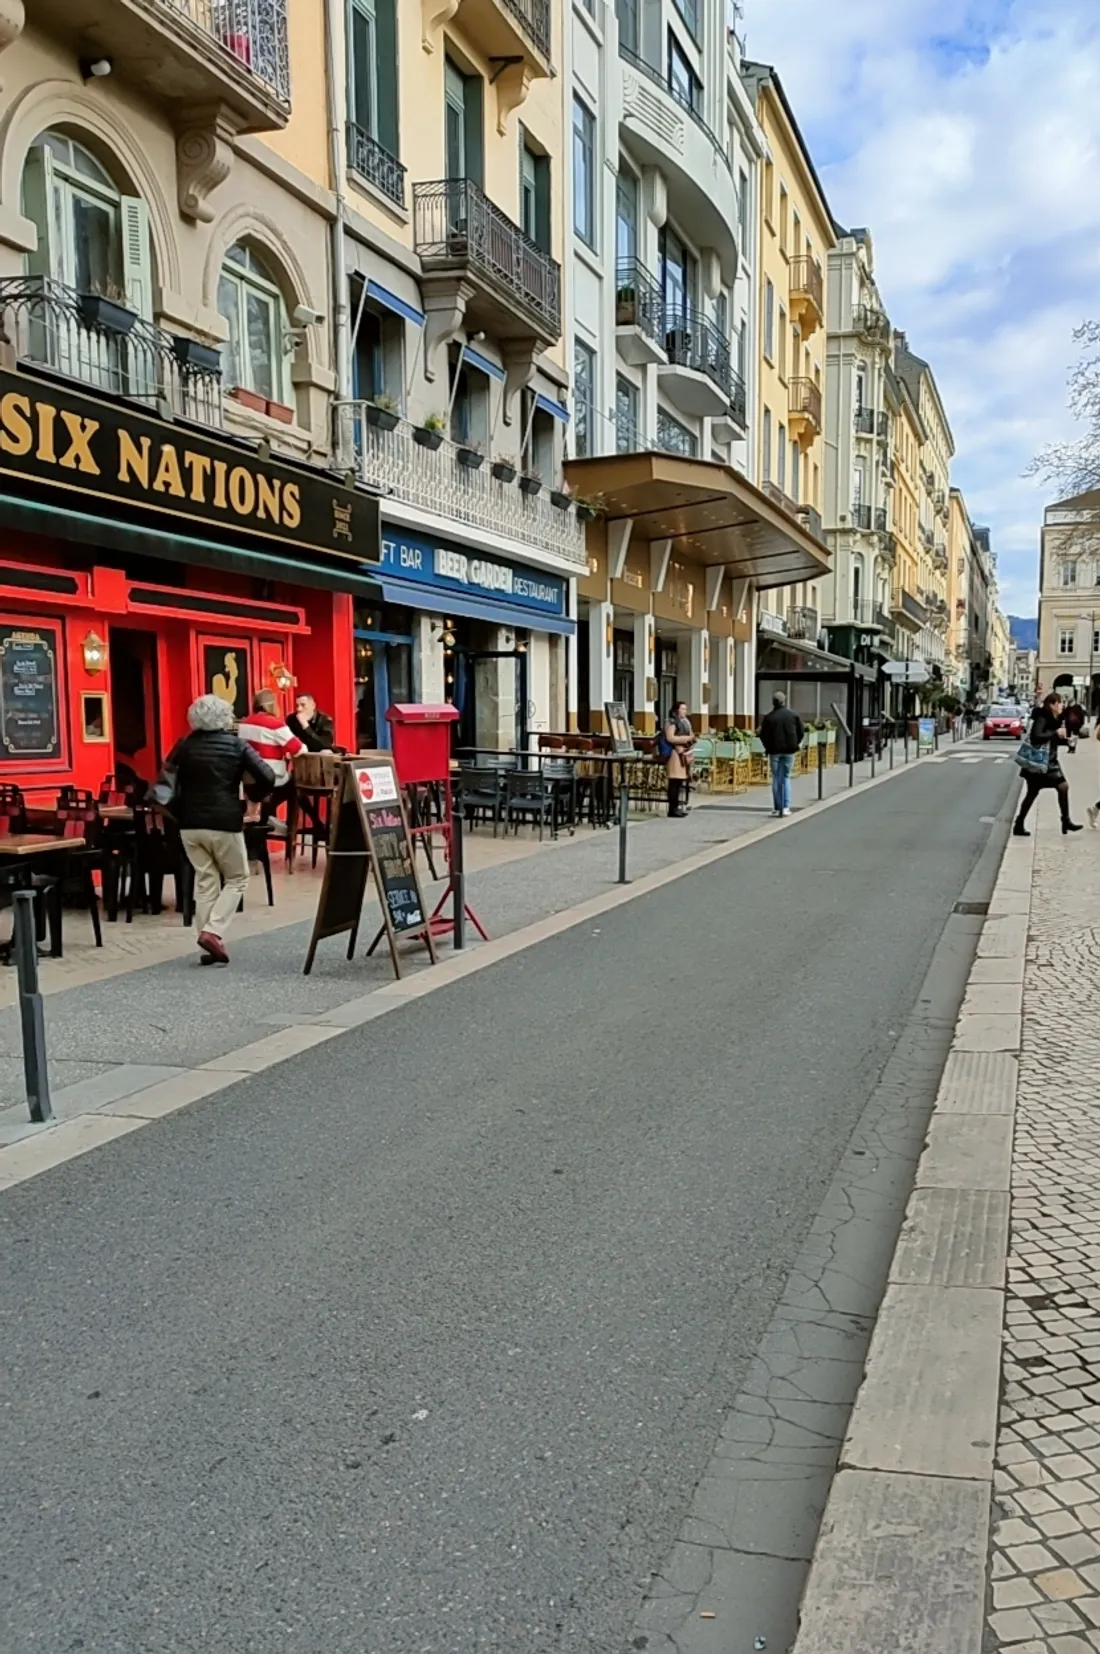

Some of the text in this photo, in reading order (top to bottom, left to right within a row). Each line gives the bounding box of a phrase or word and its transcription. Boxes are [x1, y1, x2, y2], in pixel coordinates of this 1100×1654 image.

[0, 391, 301, 529] SIX NATIONS
[400, 545, 422, 571] BAR
[434, 549, 468, 584] BEER
[470, 560, 513, 594] GARDEN
[514, 577, 558, 604] RESTAURANT
